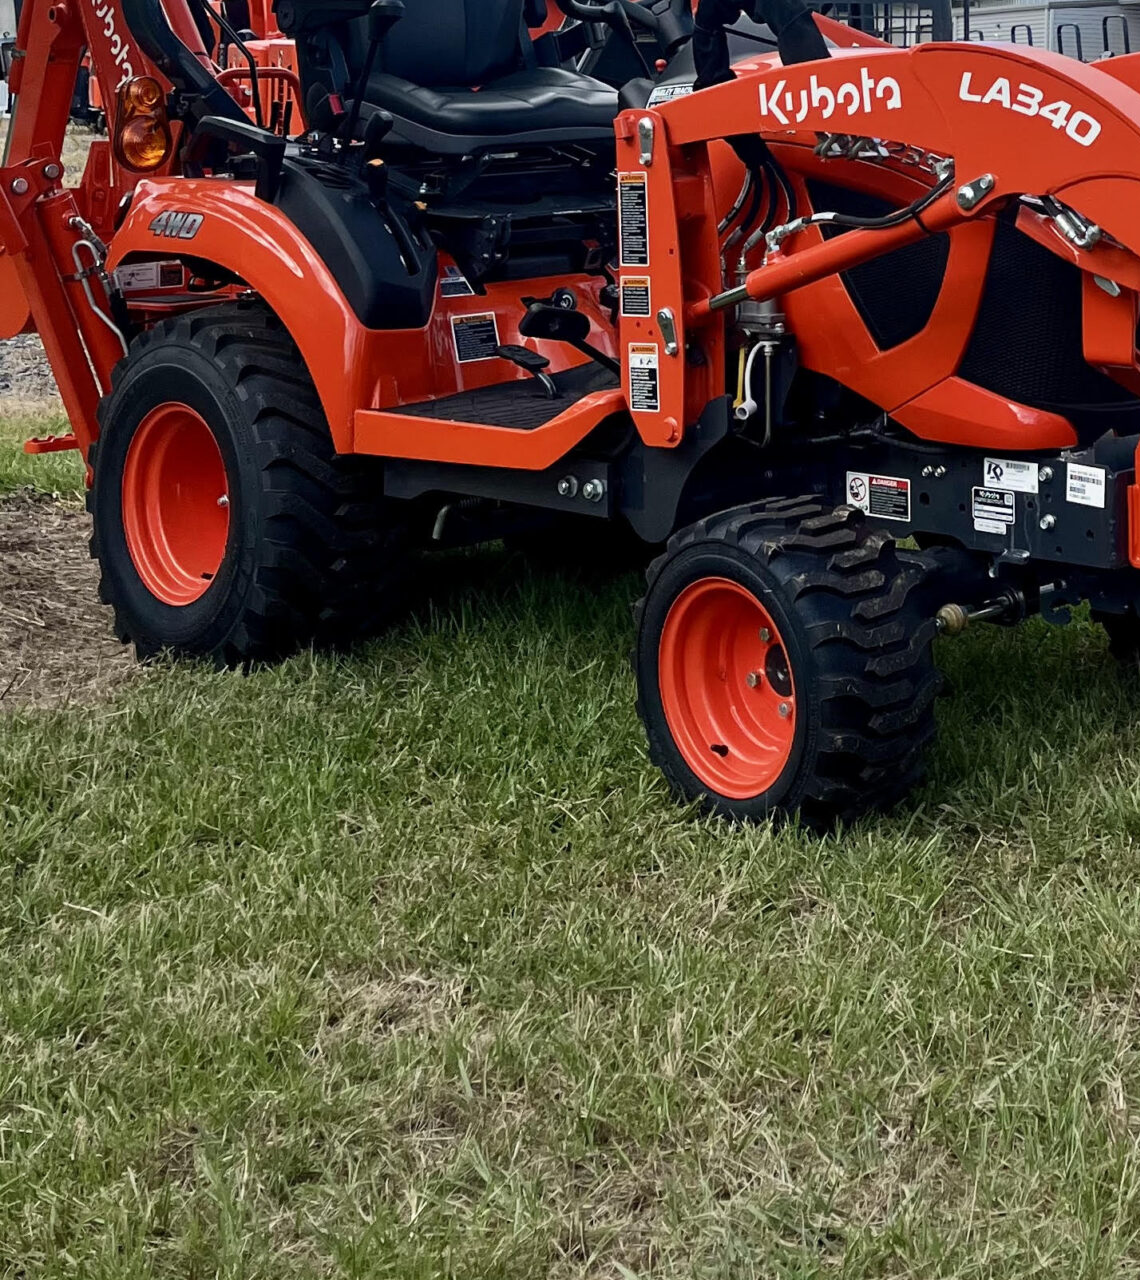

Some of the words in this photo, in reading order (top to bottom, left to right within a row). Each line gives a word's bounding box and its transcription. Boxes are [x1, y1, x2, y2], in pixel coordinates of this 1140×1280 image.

[759, 67, 902, 125] Kubota
[959, 72, 1102, 147] LA340
[148, 210, 204, 240] 4WD
